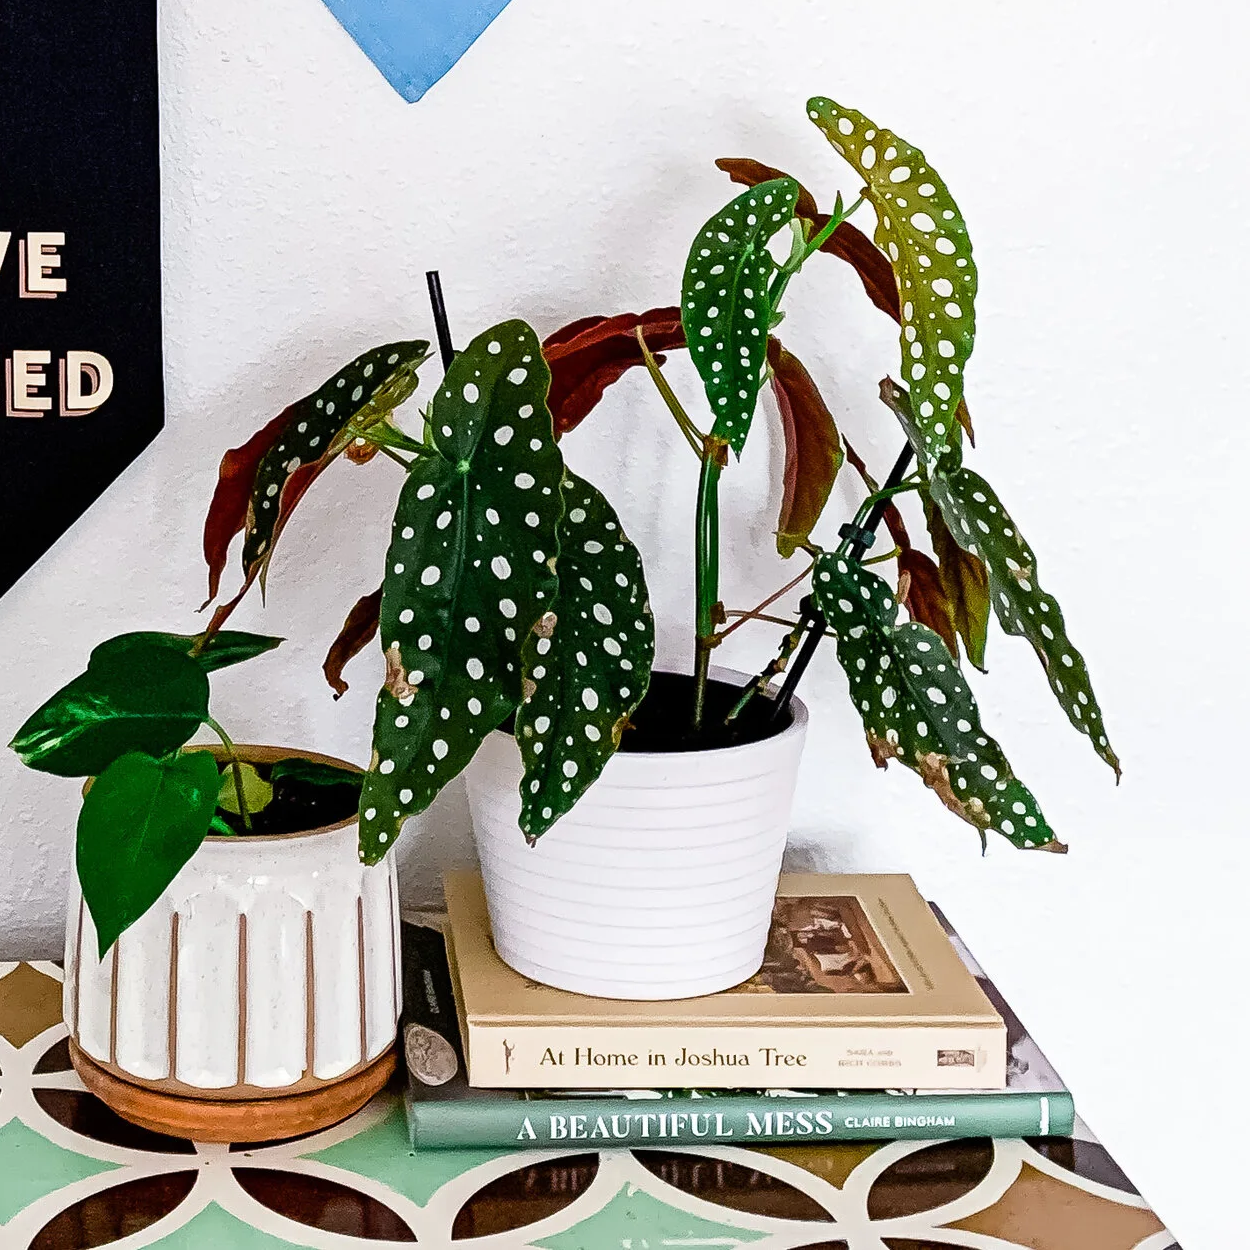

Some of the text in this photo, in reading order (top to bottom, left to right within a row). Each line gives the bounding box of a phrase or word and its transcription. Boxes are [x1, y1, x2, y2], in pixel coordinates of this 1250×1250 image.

[539, 1047, 808, 1067] At Home in Joshua Tree
[515, 1111, 834, 1141] A BEAUTIFUL MESS
[844, 1115, 957, 1129] CLAIRE BINGHAM
